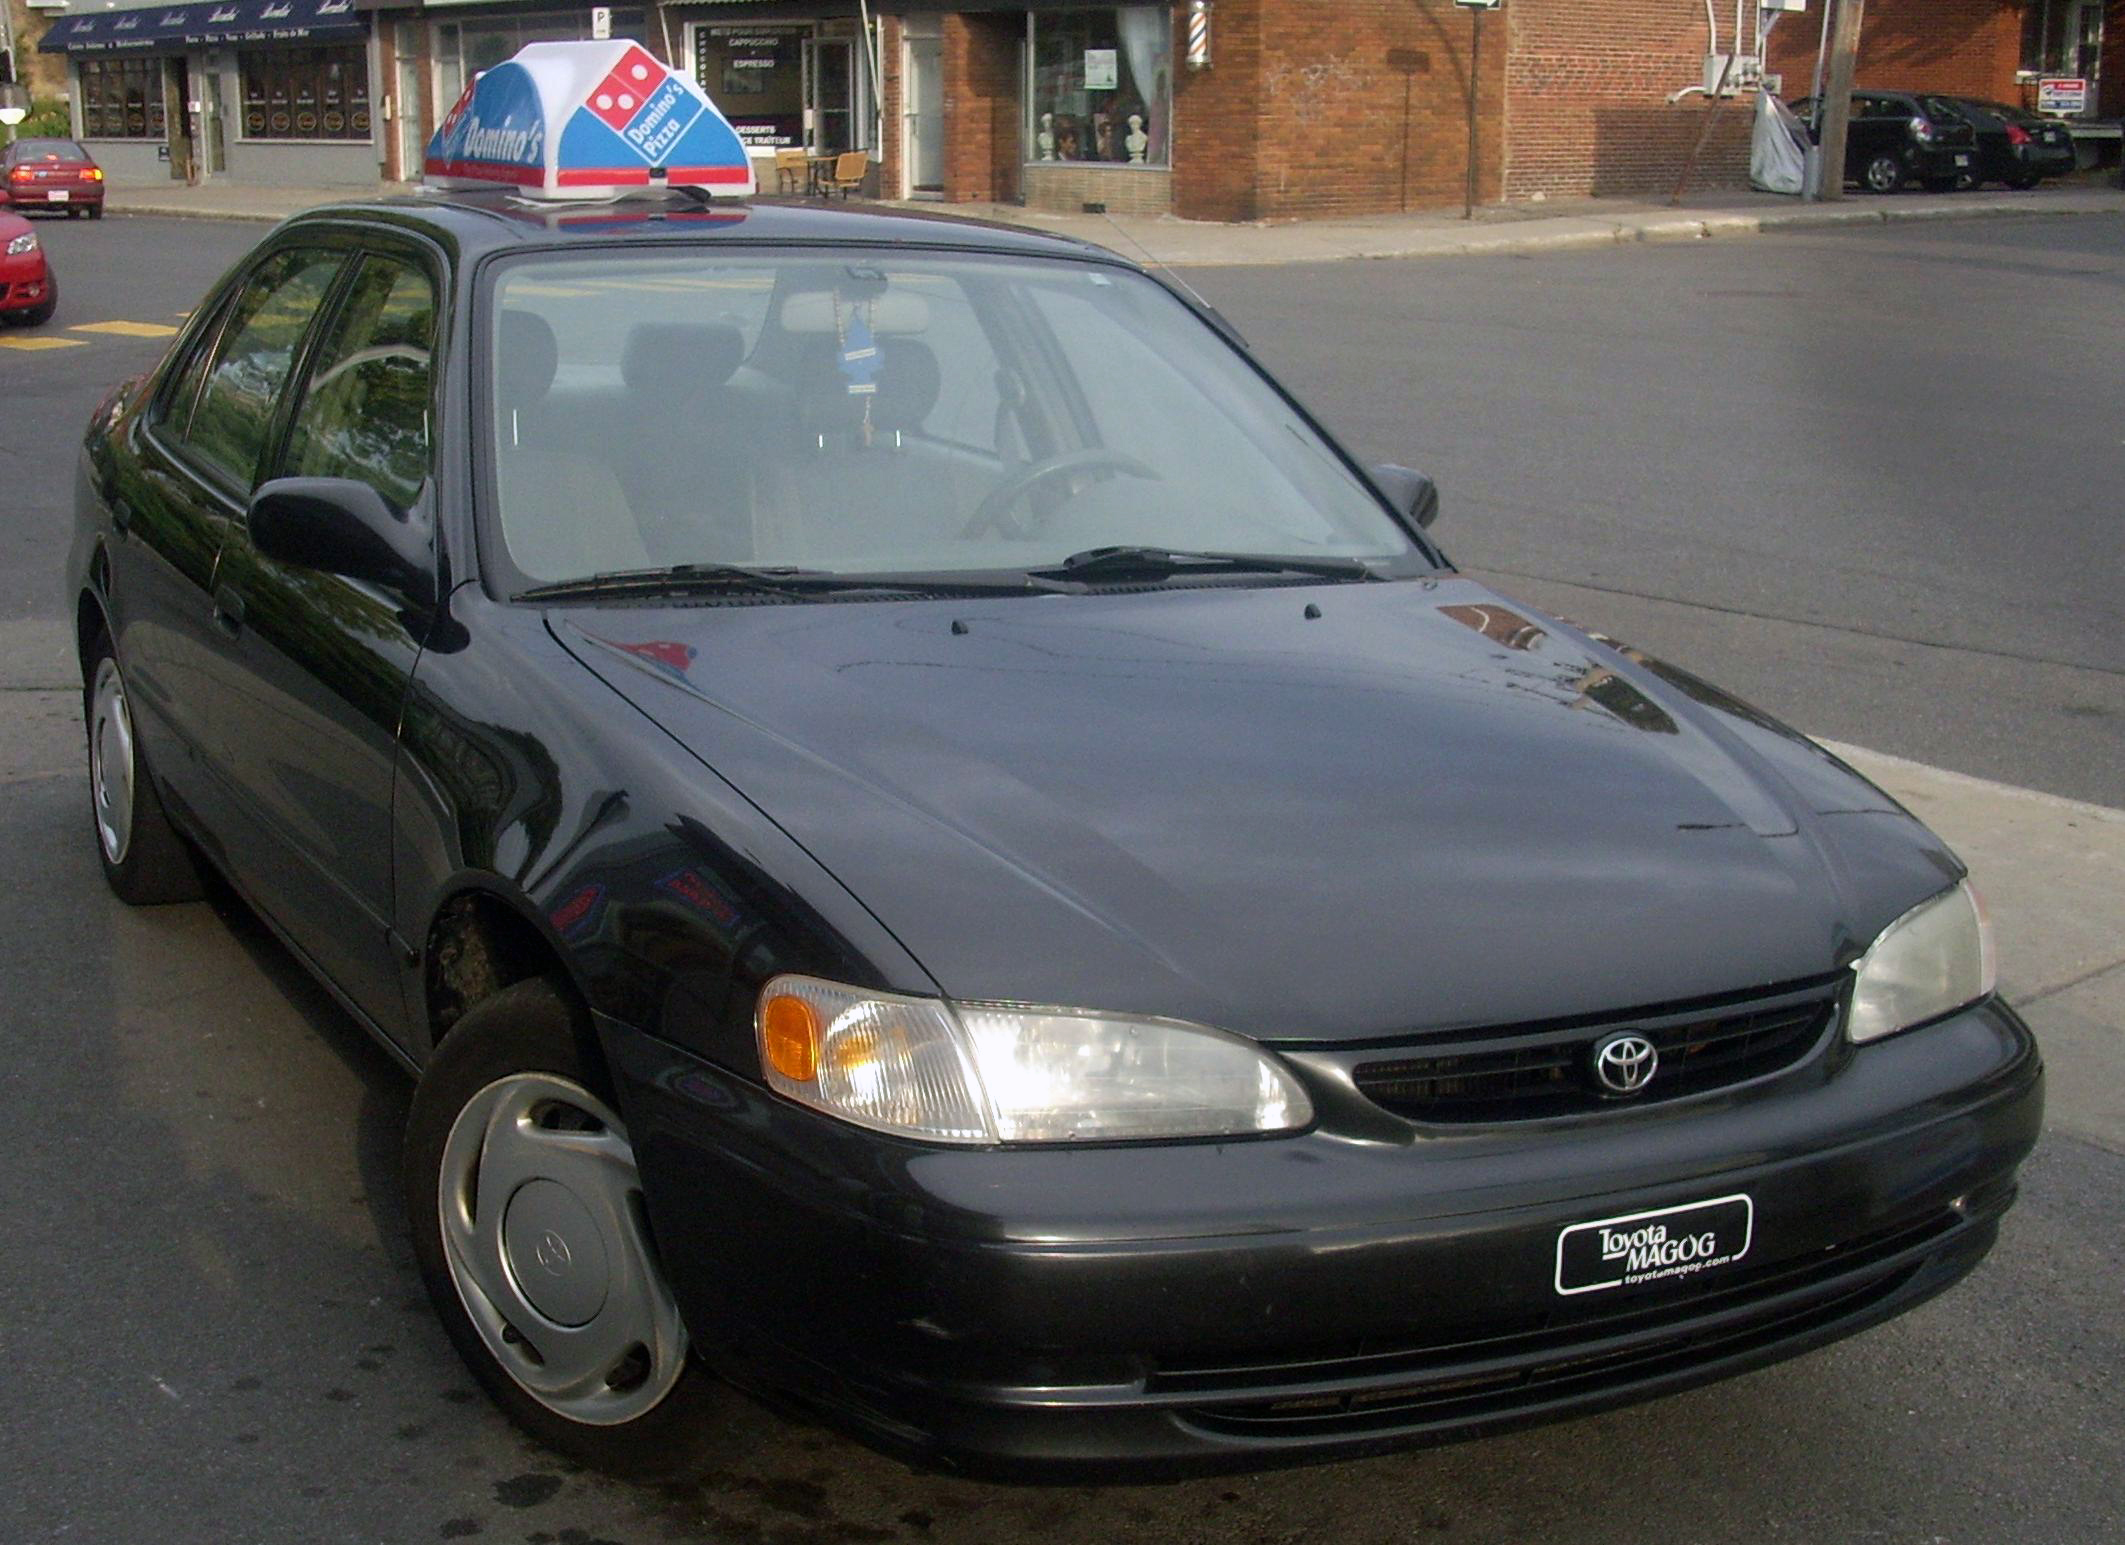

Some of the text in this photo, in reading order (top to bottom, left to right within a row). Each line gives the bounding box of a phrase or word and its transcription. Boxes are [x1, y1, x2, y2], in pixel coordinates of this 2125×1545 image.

[728, 38, 779, 48] CAPPUCCINO
[733, 59, 775, 69] ESPRESSO
[626, 83, 684, 145] Domino's
[463, 115, 543, 163] Domino's
[642, 118, 681, 157] Pizza
[1599, 1224, 1667, 1260] Toyota
[1626, 1232, 1716, 1273] MAGOG
[1625, 1255, 1730, 1285] toyotamagog.com
